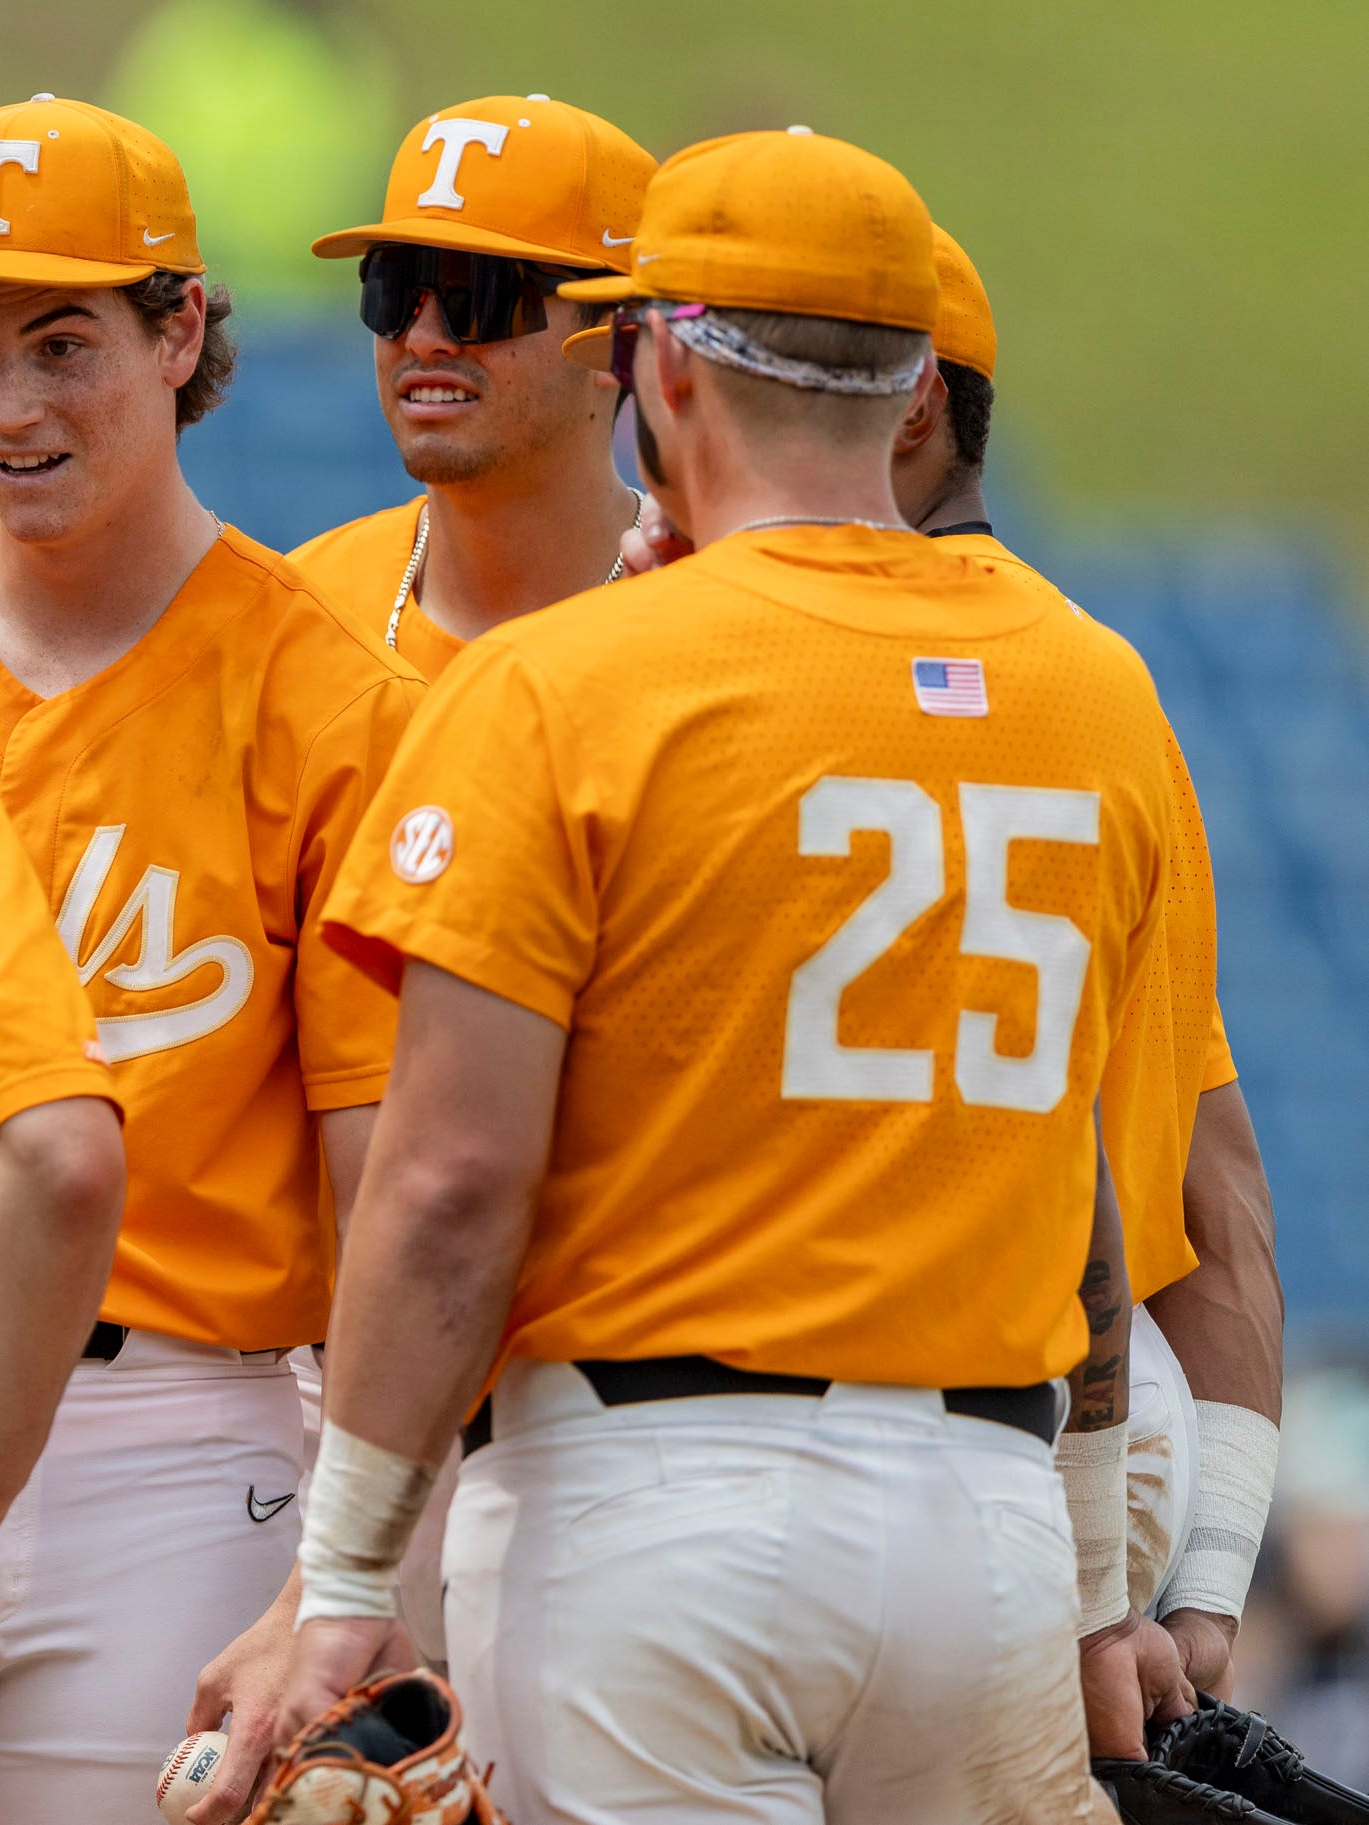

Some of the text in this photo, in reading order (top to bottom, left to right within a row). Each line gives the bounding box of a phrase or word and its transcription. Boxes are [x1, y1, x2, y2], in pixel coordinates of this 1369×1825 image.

[417, 118, 509, 210] T
[396, 812, 451, 876] SEC
[781, 775, 1100, 1114] 25
[189, 1747, 219, 1783] NCAA
